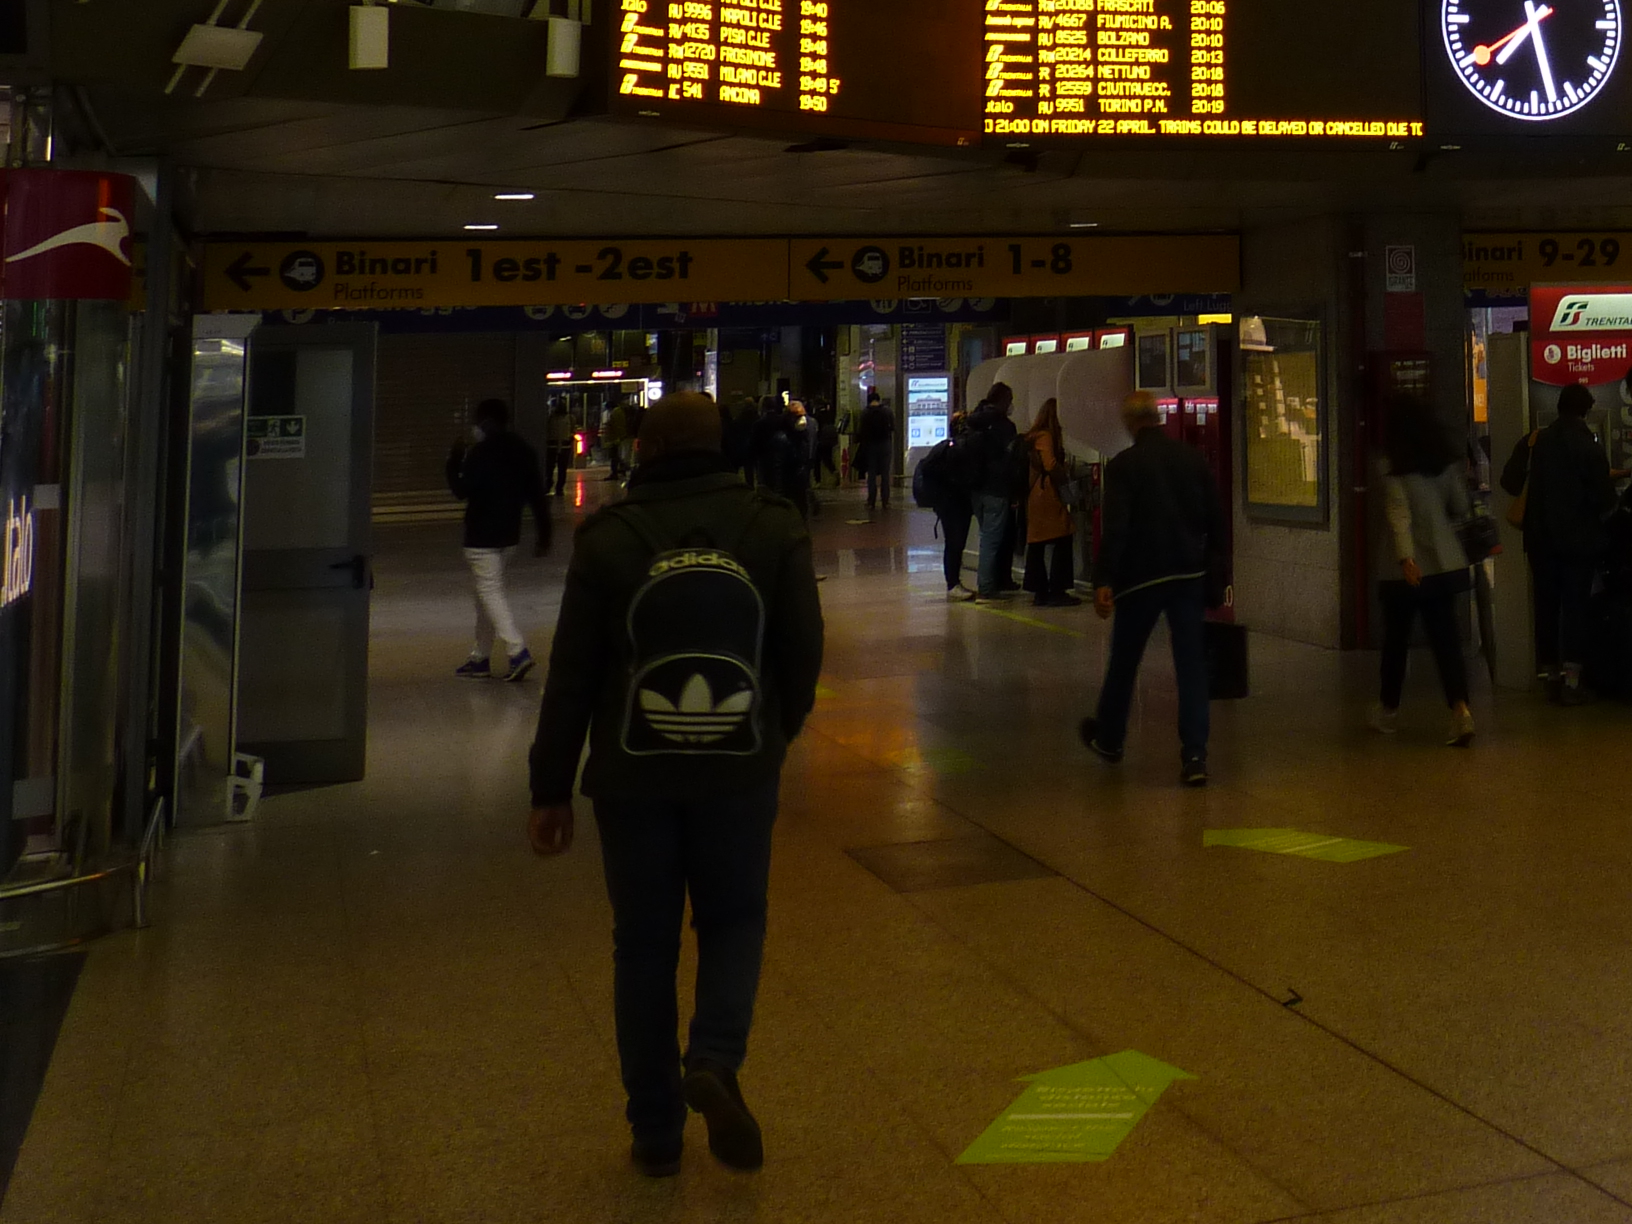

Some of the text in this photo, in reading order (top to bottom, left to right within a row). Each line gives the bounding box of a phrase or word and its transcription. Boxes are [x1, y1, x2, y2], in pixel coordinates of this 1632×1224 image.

[1191, 1, 1225, 14] 20:06
[1054, 14, 1086, 27] 4667
[1191, 18, 1223, 31] 20:10
[1191, 34, 1223, 47] 20:10
[1191, 51, 1223, 64] 20:13
[1192, 67, 1223, 80] 20:18
[1192, 84, 1224, 96] 20:18
[1192, 100, 1224, 113] 20:19
[995, 119, 1030, 133] 21:00
[1032, 120, 1050, 133] ON
[1051, 120, 1095, 134] FRIDAY
[1097, 120, 1115, 134] 22
[1160, 120, 1202, 134] TRAINS
[1203, 121, 1240, 135] COULD
[1241, 121, 1256, 135] BE
[1258, 121, 1307, 135] DELAYED
[1308, 122, 1324, 135] OR
[1326, 122, 1385, 136] CANCELLED
[1386, 122, 1408, 136] DUE
[899, 243, 1073, 275] Binari 1-8
[1462, 238, 1620, 266] inari 9-29
[335, 251, 438, 276] Binari
[1462, 266, 1515, 283] atforms
[334, 282, 424, 301] Platforms
[898, 276, 974, 292] Platforms
[1567, 343, 1627, 364] Biglietti
[1568, 362, 1595, 373] Tickets
[648, 552, 751, 579] adidas
